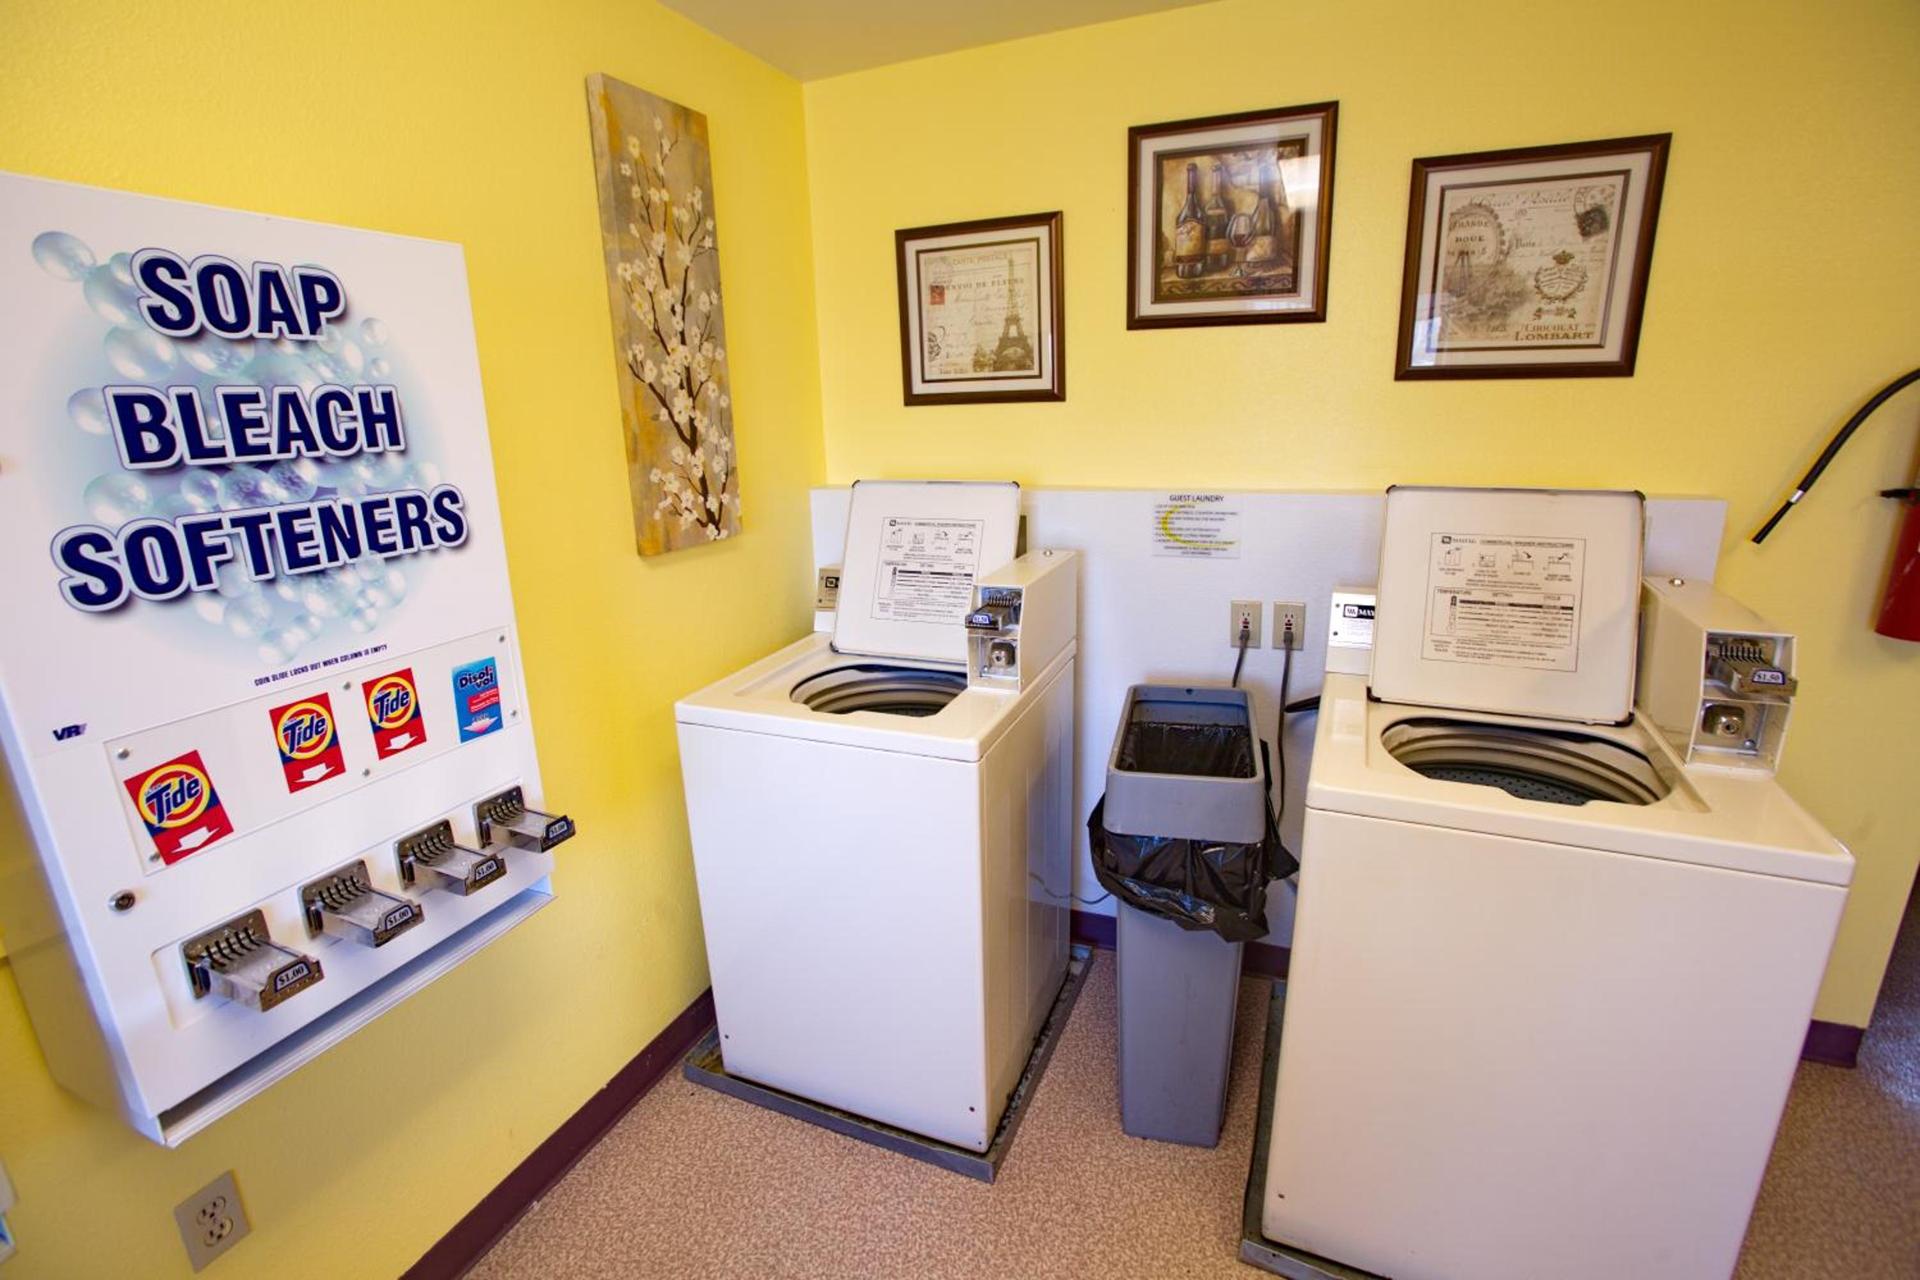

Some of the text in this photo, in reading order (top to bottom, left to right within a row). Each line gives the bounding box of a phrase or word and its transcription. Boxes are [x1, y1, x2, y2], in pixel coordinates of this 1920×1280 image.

[134, 250, 345, 338] SOAP
[107, 388, 405, 468] BLEACH
[1169, 494, 1224, 503] GUEST LAUNDRY
[55, 487, 467, 609] SOFTENERS
[310, 662, 321, 671] OUT
[323, 658, 339, 667] WHEN
[340, 651, 363, 663] COLUMN
[371, 644, 388, 654] EMPTY
[373, 687, 410, 724] Tide
[282, 714, 326, 755] Tide
[144, 776, 201, 825] Tide
[388, 909, 409, 926] $1.00
[278, 965, 305, 986] $1.00
